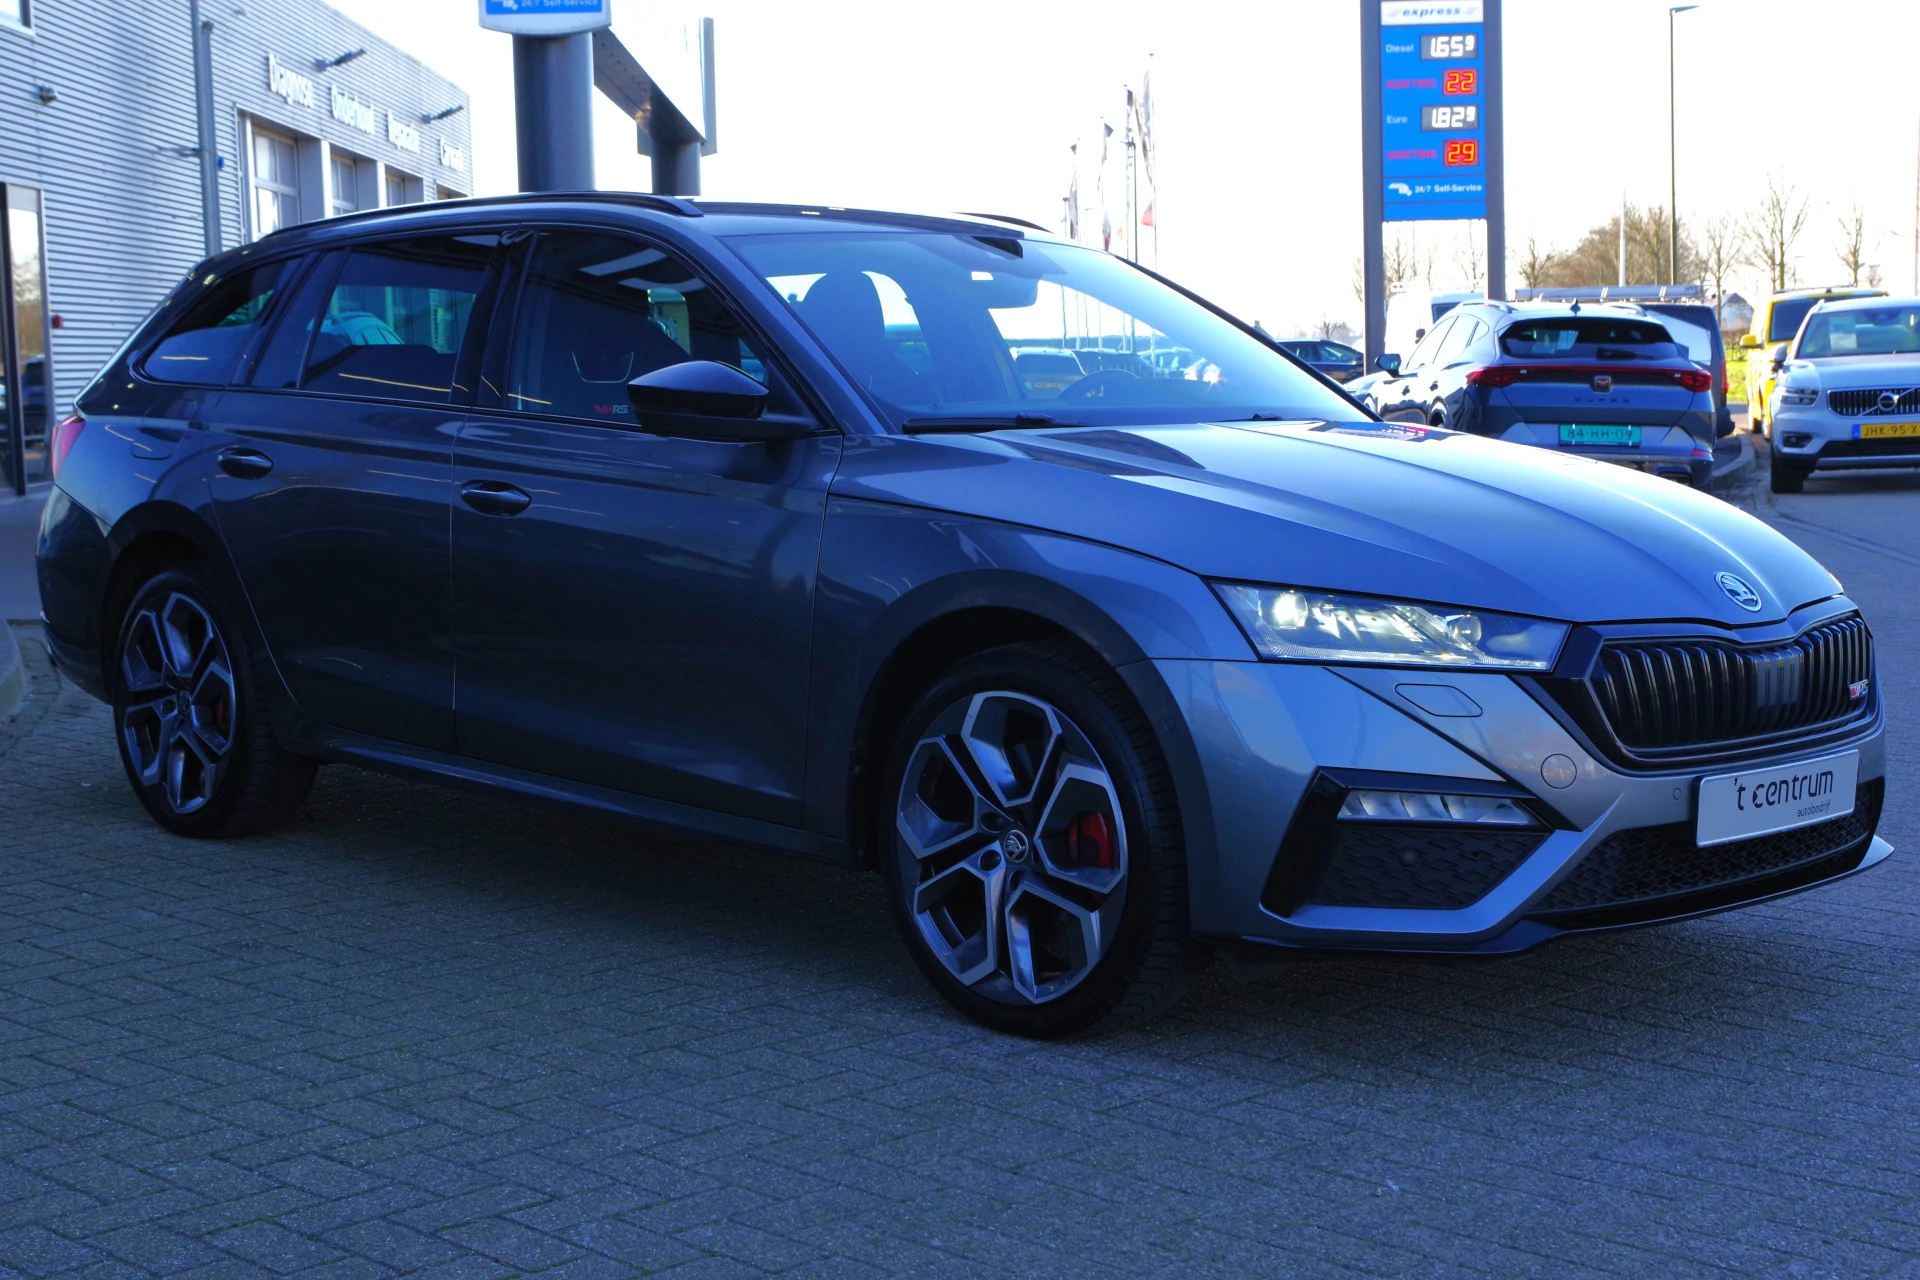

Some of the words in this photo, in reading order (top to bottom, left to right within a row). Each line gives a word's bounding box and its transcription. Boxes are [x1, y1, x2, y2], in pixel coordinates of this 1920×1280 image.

[1402, 7, 1461, 18] express
[1385, 43, 1414, 53] Diesel
[1445, 70, 1475, 94] 22
[1386, 115, 1408, 124] Euro
[1447, 141, 1476, 165] 29
[1414, 185, 1431, 194] 24/7
[1434, 183, 1482, 193] Self-Service
[1752, 771, 1834, 808] centrum
[1796, 800, 1832, 818] autobedrijf
